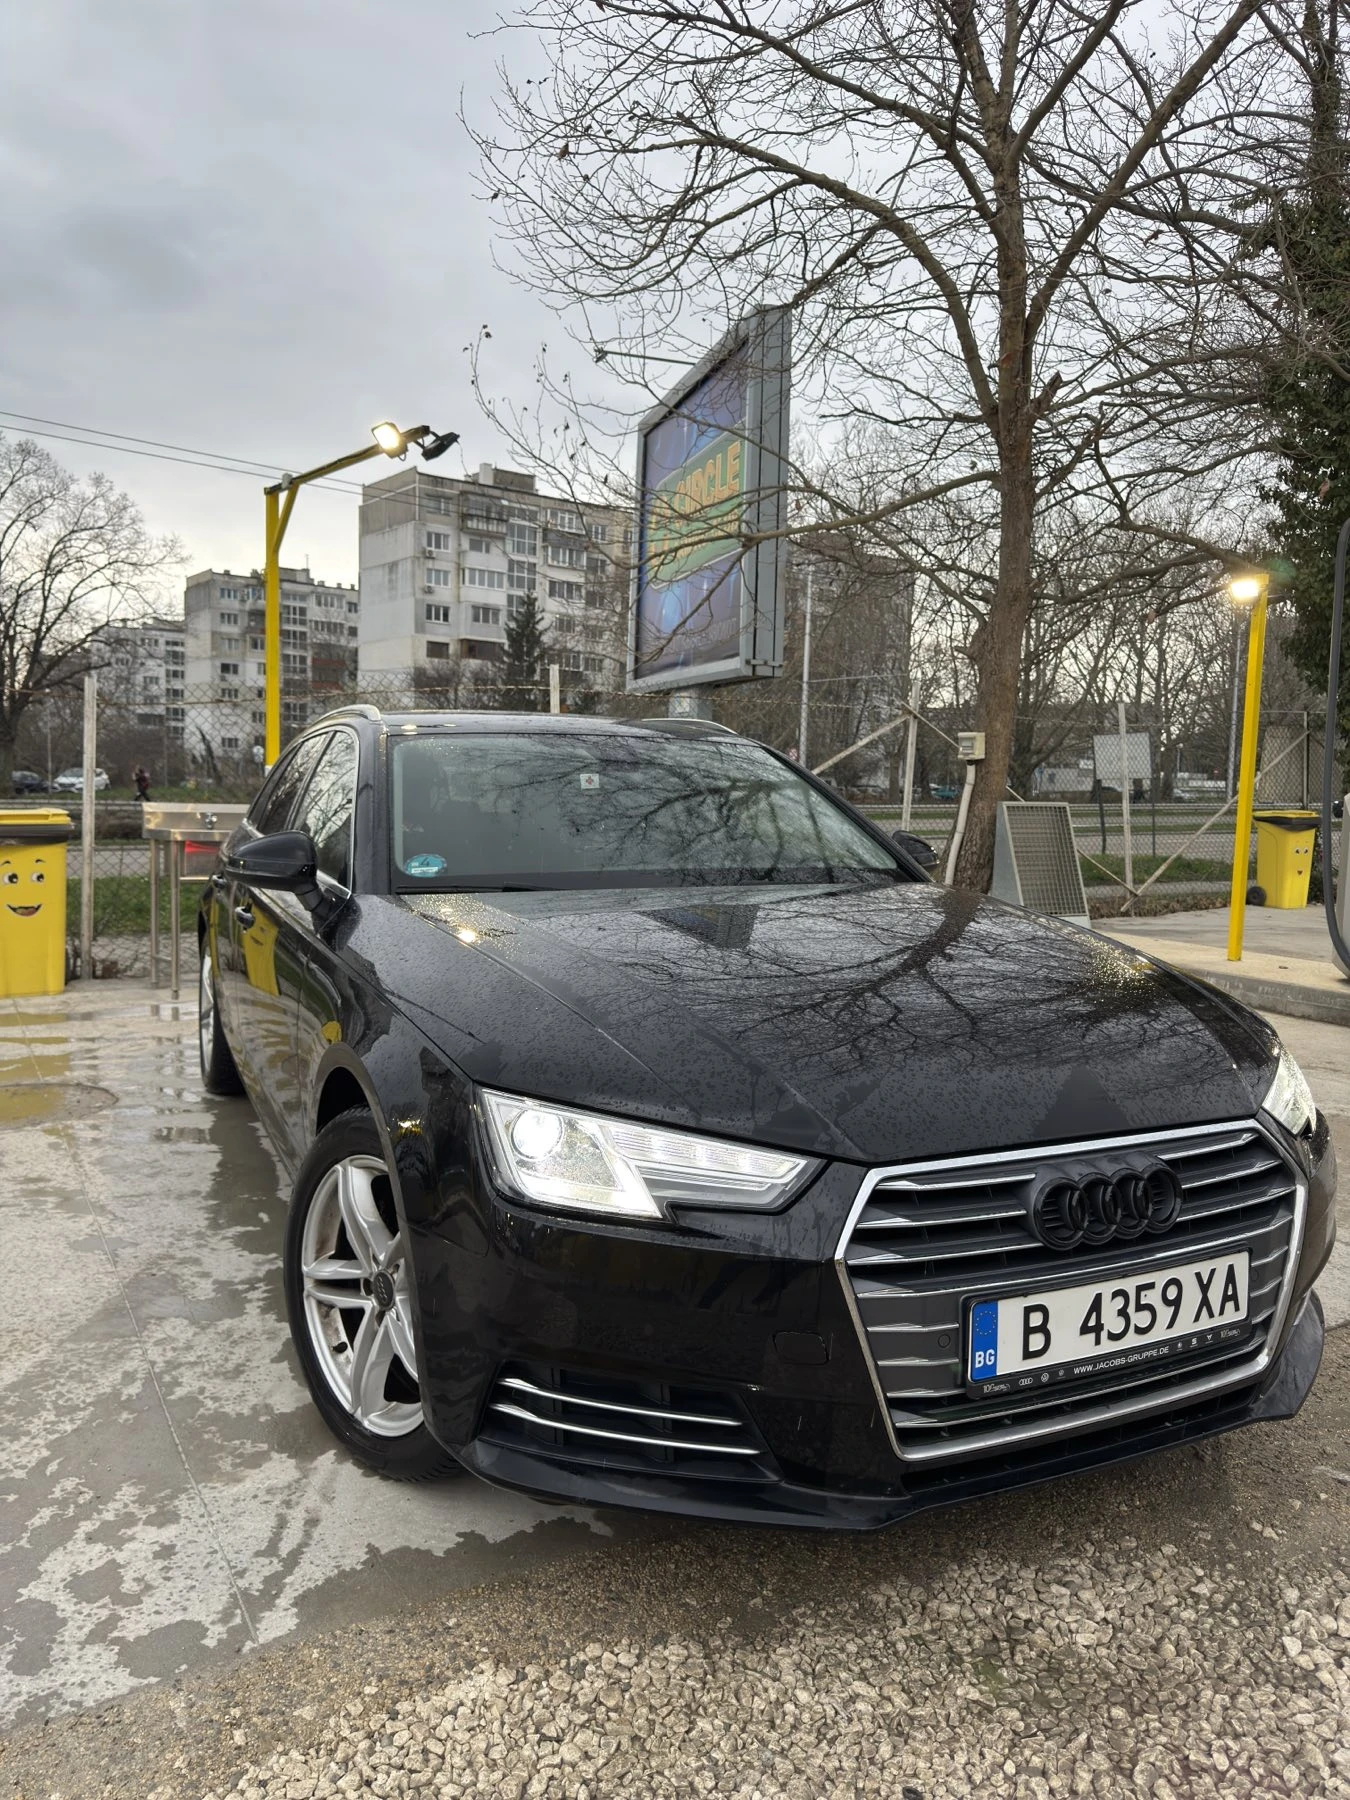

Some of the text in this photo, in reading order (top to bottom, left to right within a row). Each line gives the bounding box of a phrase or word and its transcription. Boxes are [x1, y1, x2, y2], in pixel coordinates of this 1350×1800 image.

[673, 440, 741, 528] CIRCLE
[1022, 1263, 1241, 1361] B 4359 XA
[975, 1348, 996, 1369] BG
[1073, 1345, 1170, 1376] WWW.JACOBS-GRUPPE.DE
